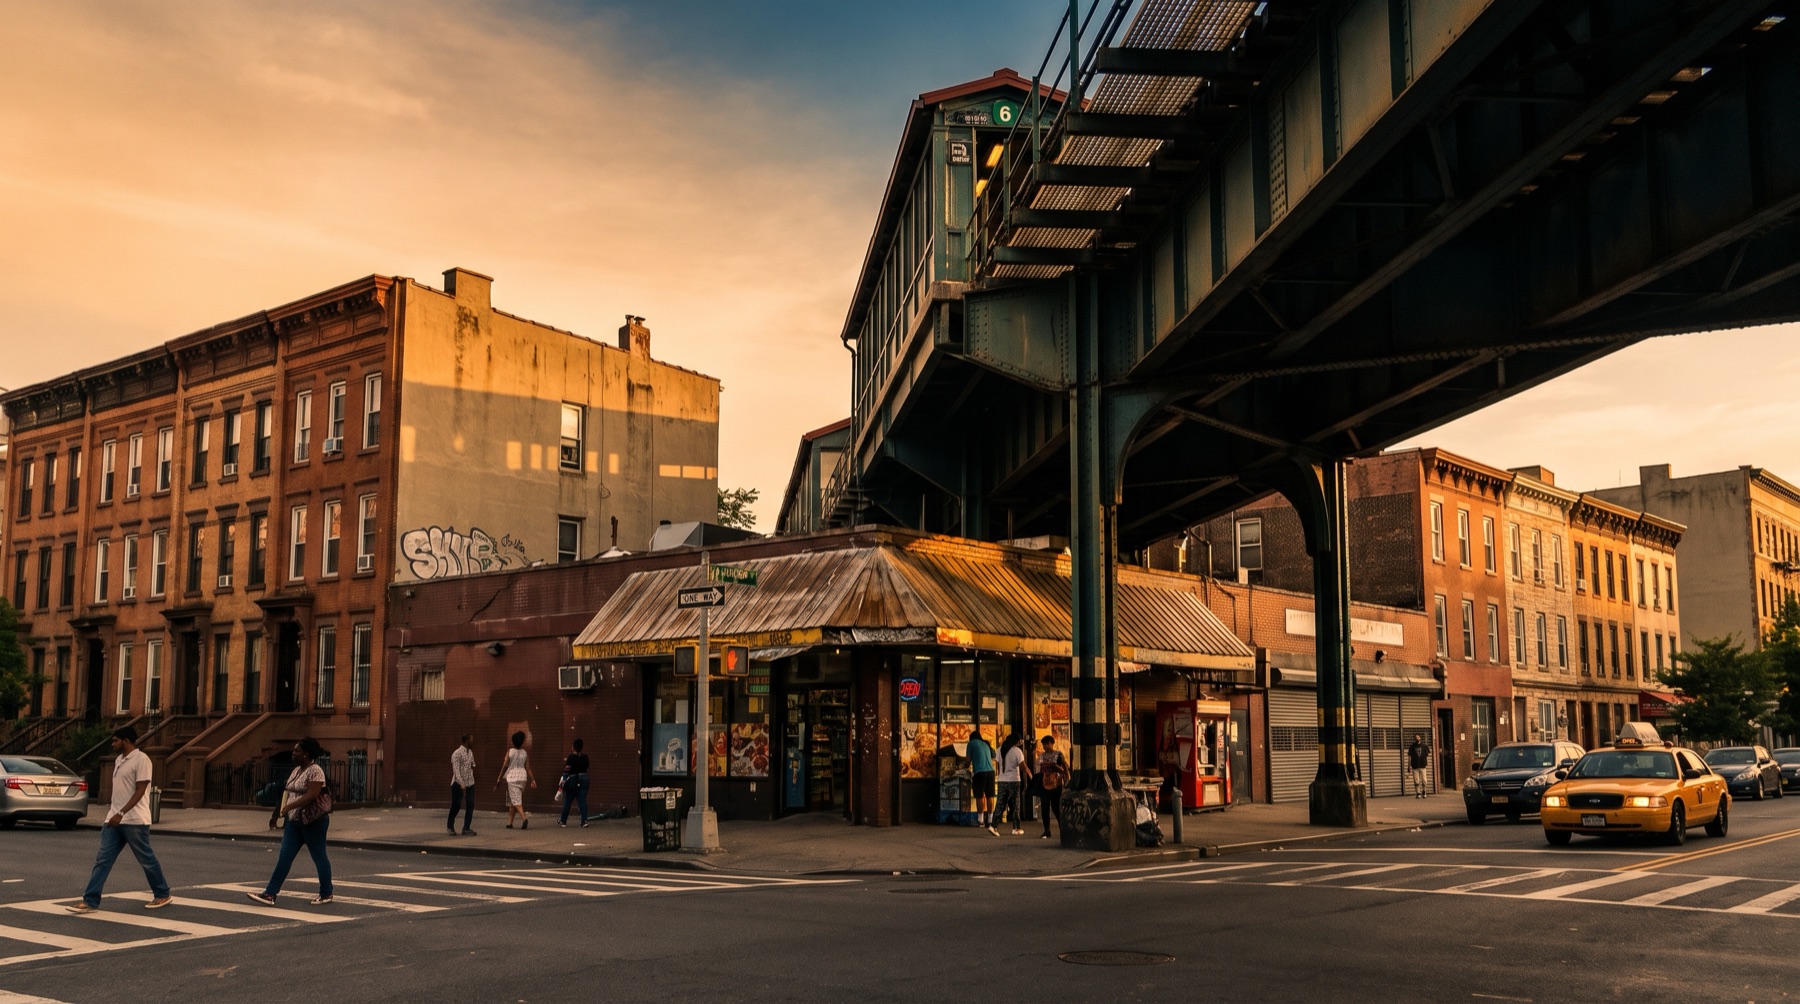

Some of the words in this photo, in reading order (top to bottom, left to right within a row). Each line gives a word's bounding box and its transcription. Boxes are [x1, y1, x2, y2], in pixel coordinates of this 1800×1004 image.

[1000, 106, 1011, 122] 6
[684, 594, 698, 603] ONE
[703, 592, 717, 601] WAY
